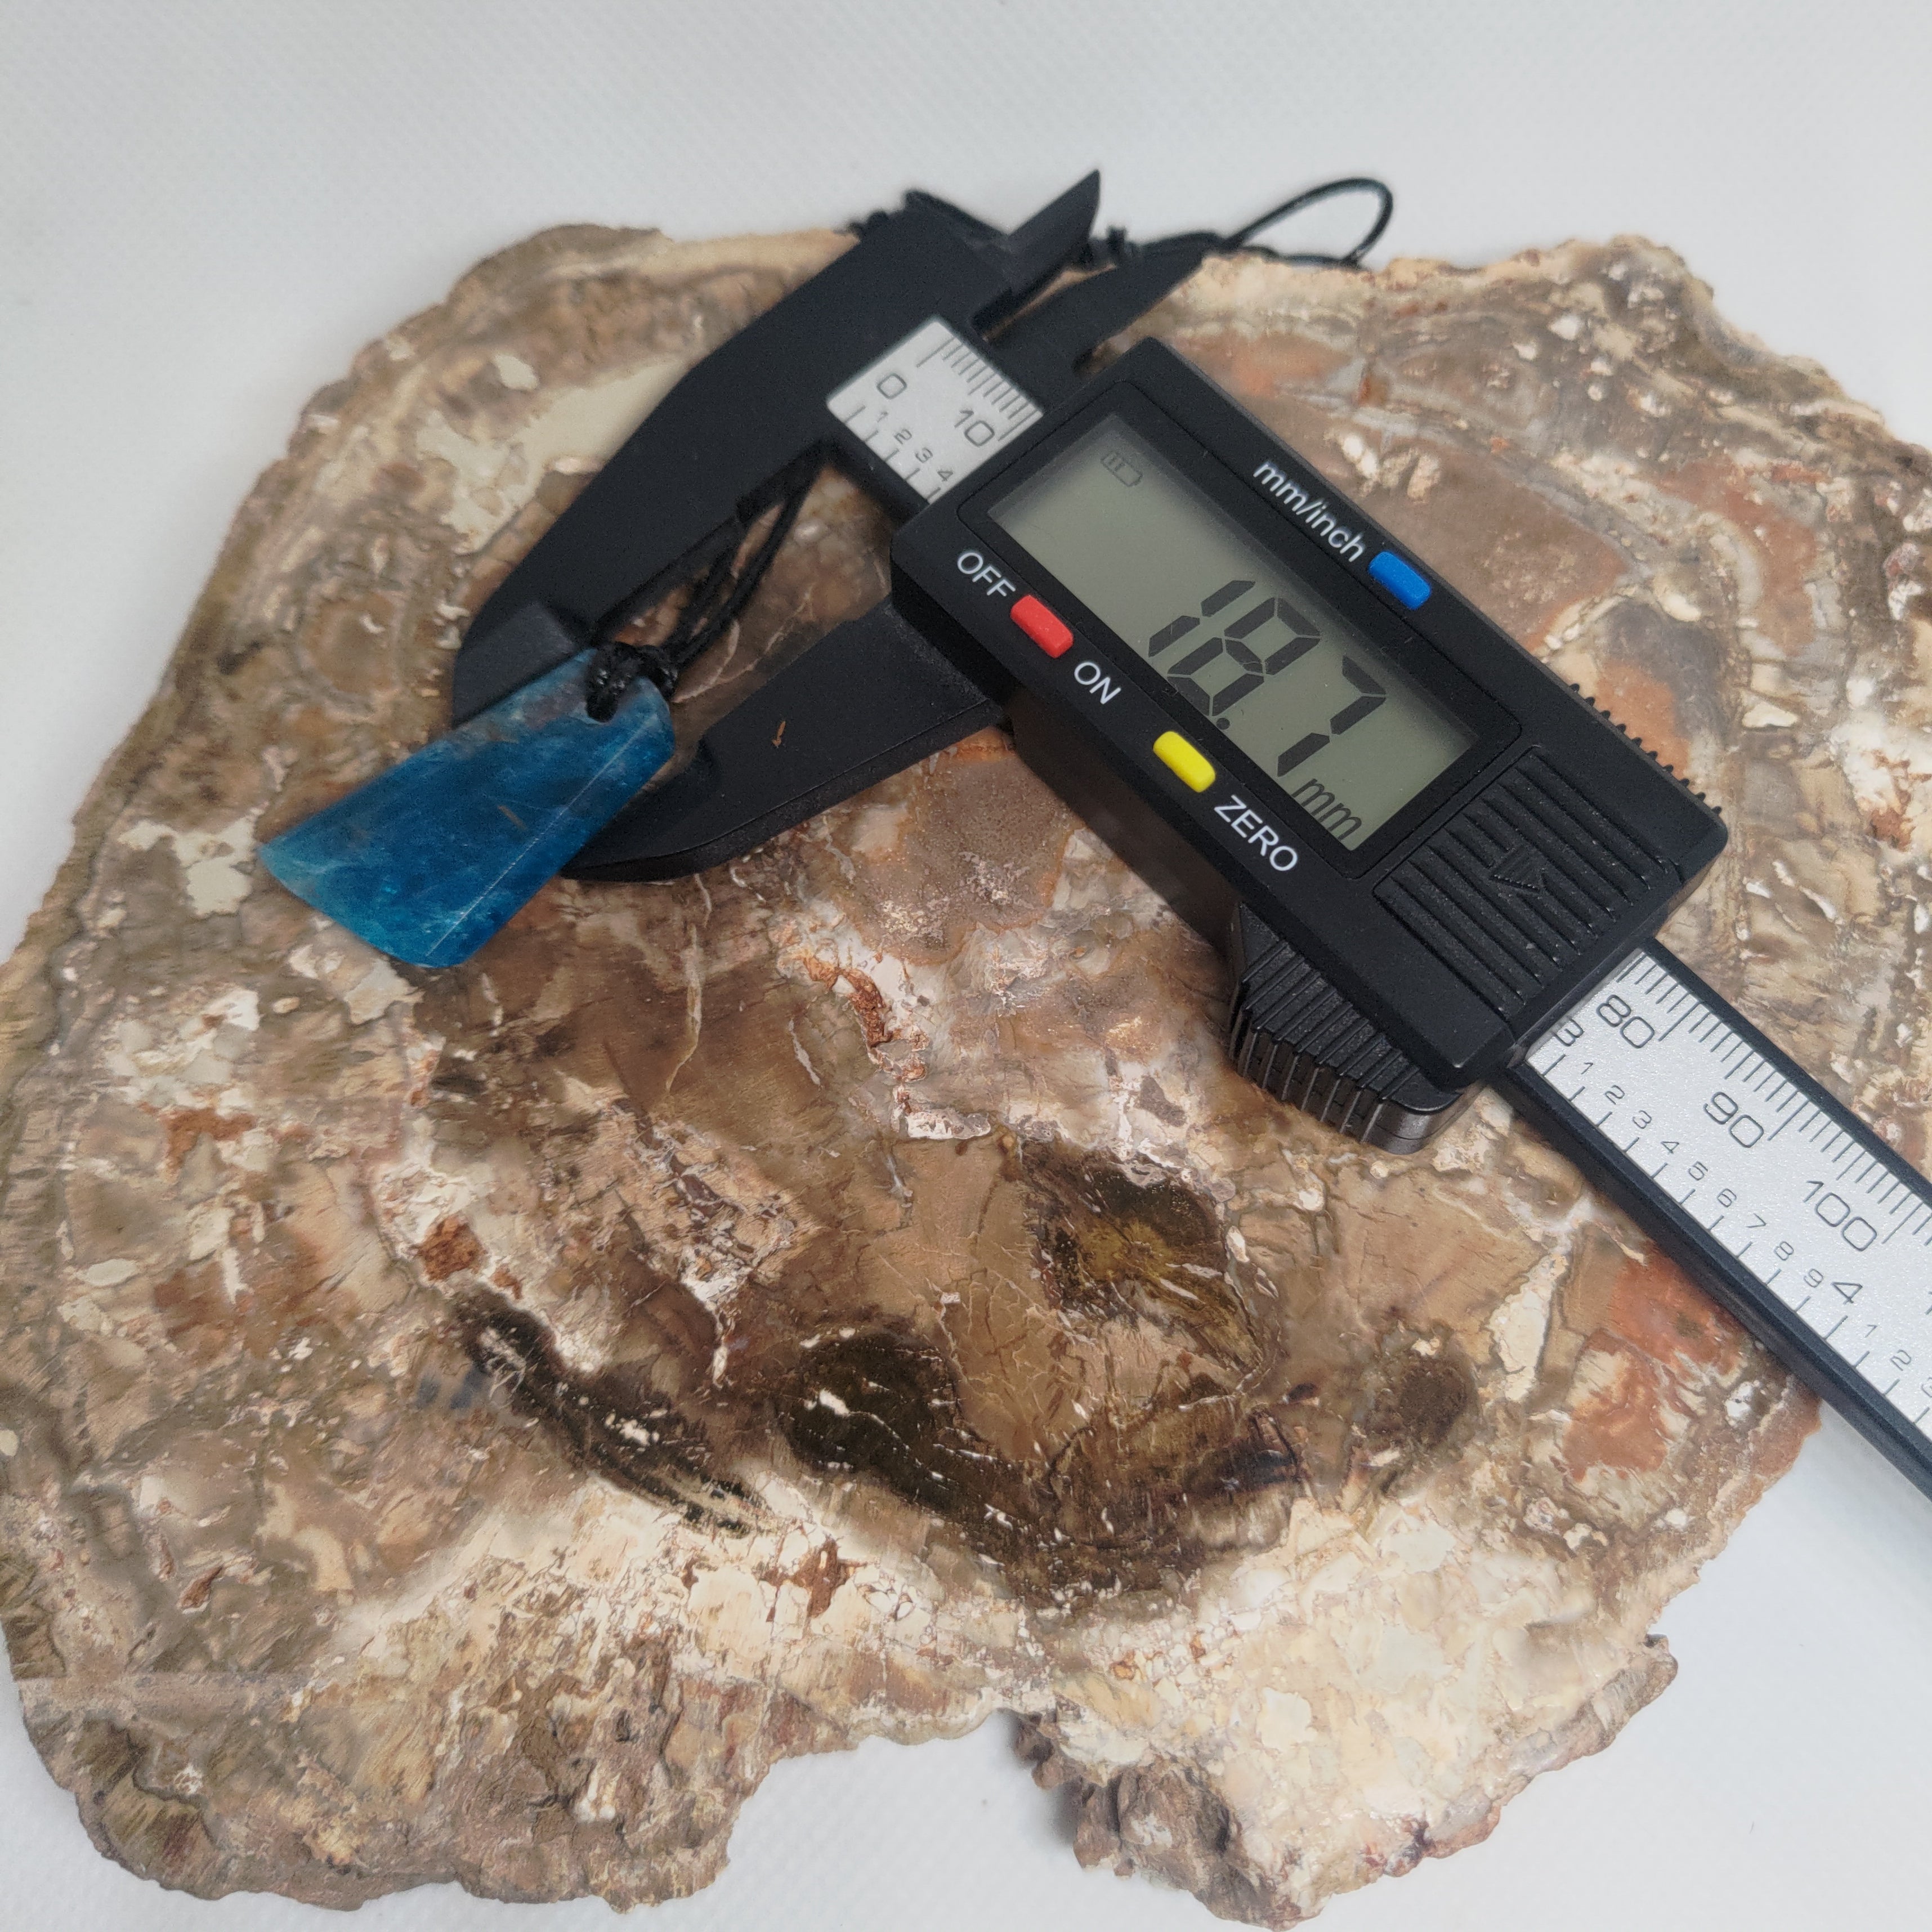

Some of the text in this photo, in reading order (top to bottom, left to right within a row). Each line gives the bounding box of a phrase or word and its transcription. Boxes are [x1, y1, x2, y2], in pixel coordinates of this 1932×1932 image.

[876, 373, 995, 447] 0 10
[877, 411, 954, 481] 1 2 3 4
[1253, 459, 1365, 562] mm/inch
[956, 550, 1016, 600] OFF
[1073, 660, 1121, 705] ON
[1148, 579, 1387, 840] 18.7 mm
[1214, 794, 1298, 871] ZERO
[1596, 994, 1877, 1251] 80 90 100
[1581, 1062, 1594, 1075] 1
[1604, 1085, 1625, 1104] 2
[1633, 1110, 1652, 1129] 3
[1661, 1140, 1680, 1154] 4
[1688, 1161, 1709, 1181] 5
[1716, 1188, 1737, 1208] 6
[1747, 1213, 1767, 1229] 7
[1773, 1241, 1795, 1261] 8
[1803, 1268, 1824, 1288] 9
[1832, 1281, 1863, 1304] 4
[1866, 1323, 1877, 1337] 1
[1889, 1349, 1912, 1371] 2
